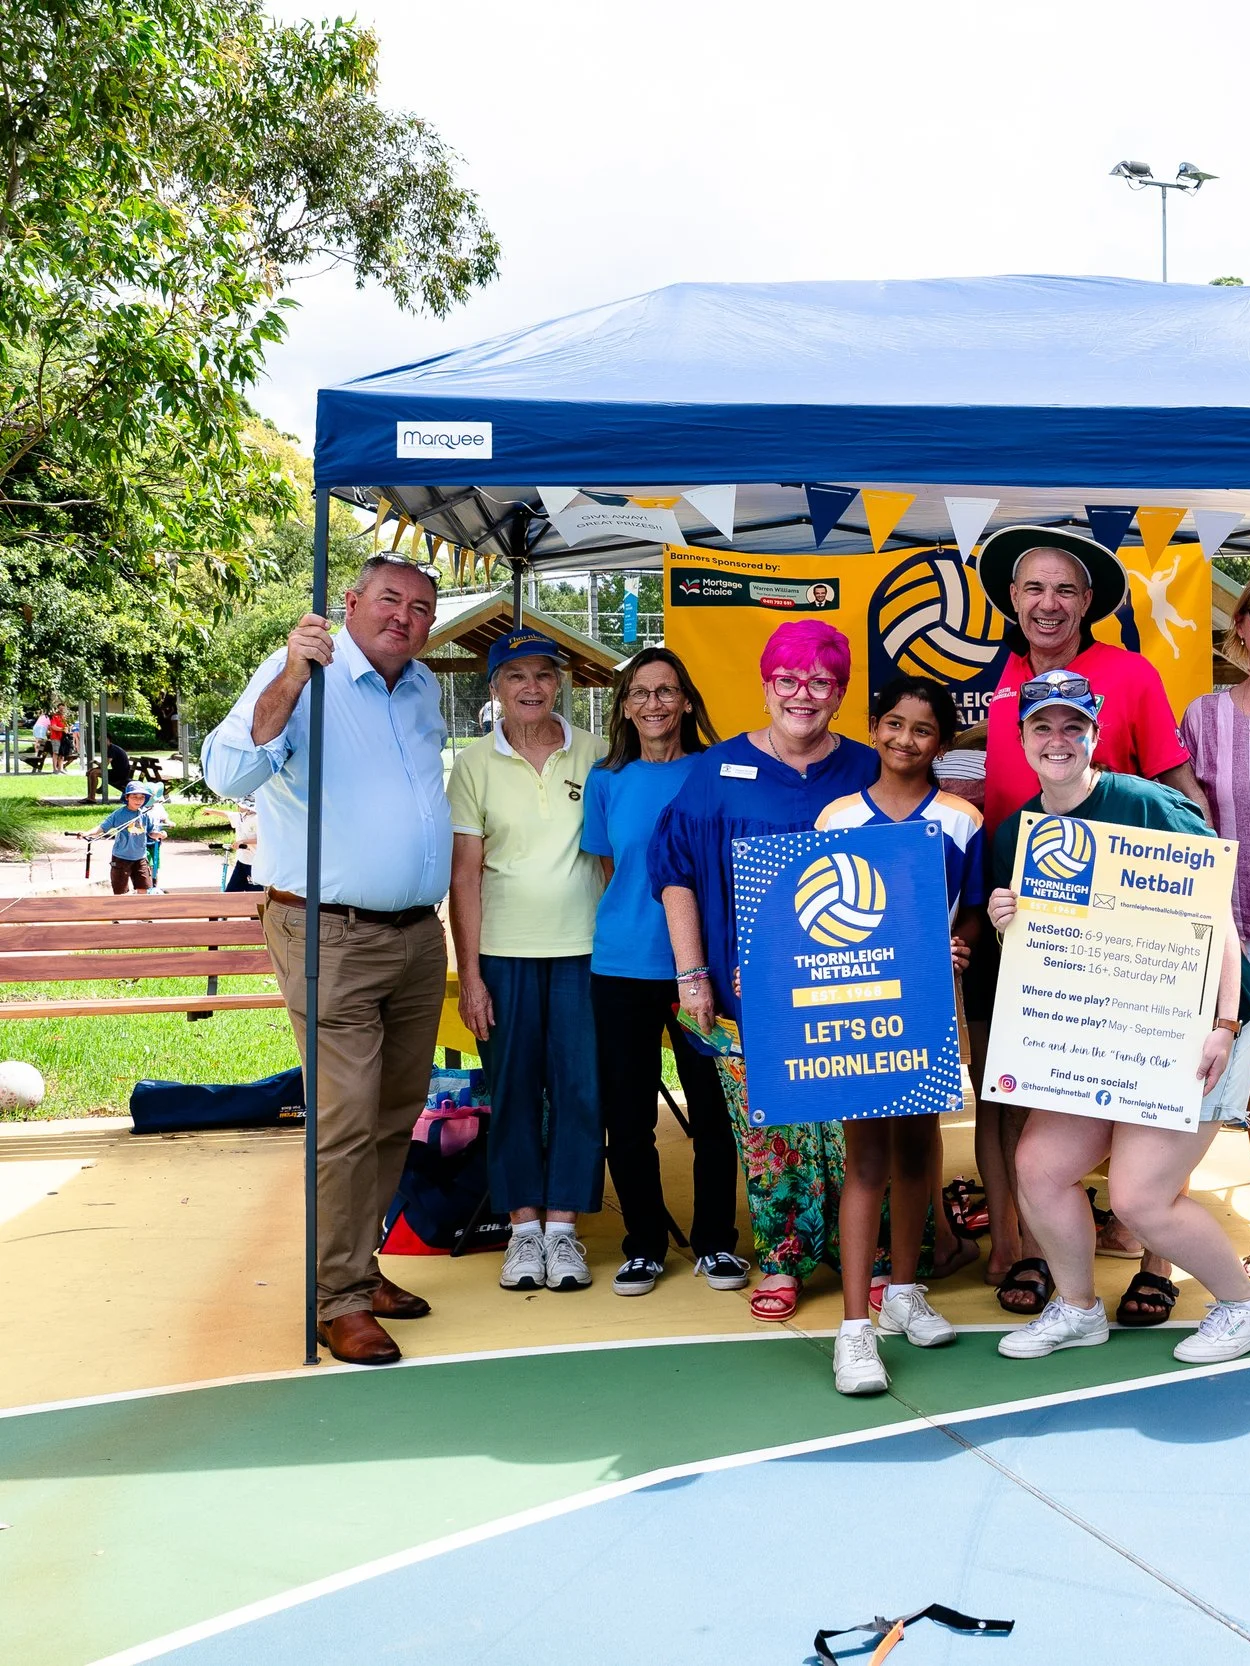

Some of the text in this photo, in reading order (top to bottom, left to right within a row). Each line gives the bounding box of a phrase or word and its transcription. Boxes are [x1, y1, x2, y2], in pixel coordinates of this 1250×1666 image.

[577, 520, 613, 529] GREAT
[612, 513, 648, 521] AWAY!
[670, 552, 781, 573] Banners Sponsored by:
[702, 579, 743, 589] Mortgage
[702, 587, 733, 596] Choice
[752, 585, 799, 594] Warren Williams
[1108, 835, 1215, 871] Thornleigh
[1024, 876, 1089, 895] THORNLEIGH
[1120, 868, 1194, 897] Netball
[1032, 887, 1078, 902] NETBALL
[1120, 902, 1212, 920] thornleighnetballclub@gmail.com
[1027, 921, 1201, 958] NetSetGO: 6-9 years, Friday Nights
[794, 947, 895, 968] THORNLEIGH
[1026, 938, 1198, 973] Juniors: 10-15 years, Saturday AM
[810, 963, 880, 981] NETBALL
[1043, 956, 1176, 985] Seniors: 16+, Saturday PM
[811, 986, 883, 1002] EST. 1968
[1022, 984, 1193, 1019] Where do we play? Pennant Hills Park
[804, 1015, 904, 1044] LET'S GO
[1022, 1007, 1050, 1020] When
[1051, 1011, 1064, 1022] do
[1065, 1015, 1080, 1024] we
[1080, 1016, 1108, 1029] play?
[1108, 1019, 1128, 1033] May
[1134, 1023, 1186, 1040] September
[1022, 1036, 1046, 1049] Come
[1048, 1041, 1067, 1053] and
[1069, 1045, 1090, 1056] Join
[1091, 1047, 1106, 1058] the
[1110, 1049, 1147, 1067] "Family
[784, 1048, 929, 1081] THORNLEIGH
[1050, 1068, 1138, 1090] Find us on socials!
[1021, 1081, 1091, 1099] @thornleighnetball
[1118, 1096, 1184, 1113] Thornleigh Netball
[1140, 1111, 1158, 1120] Club
